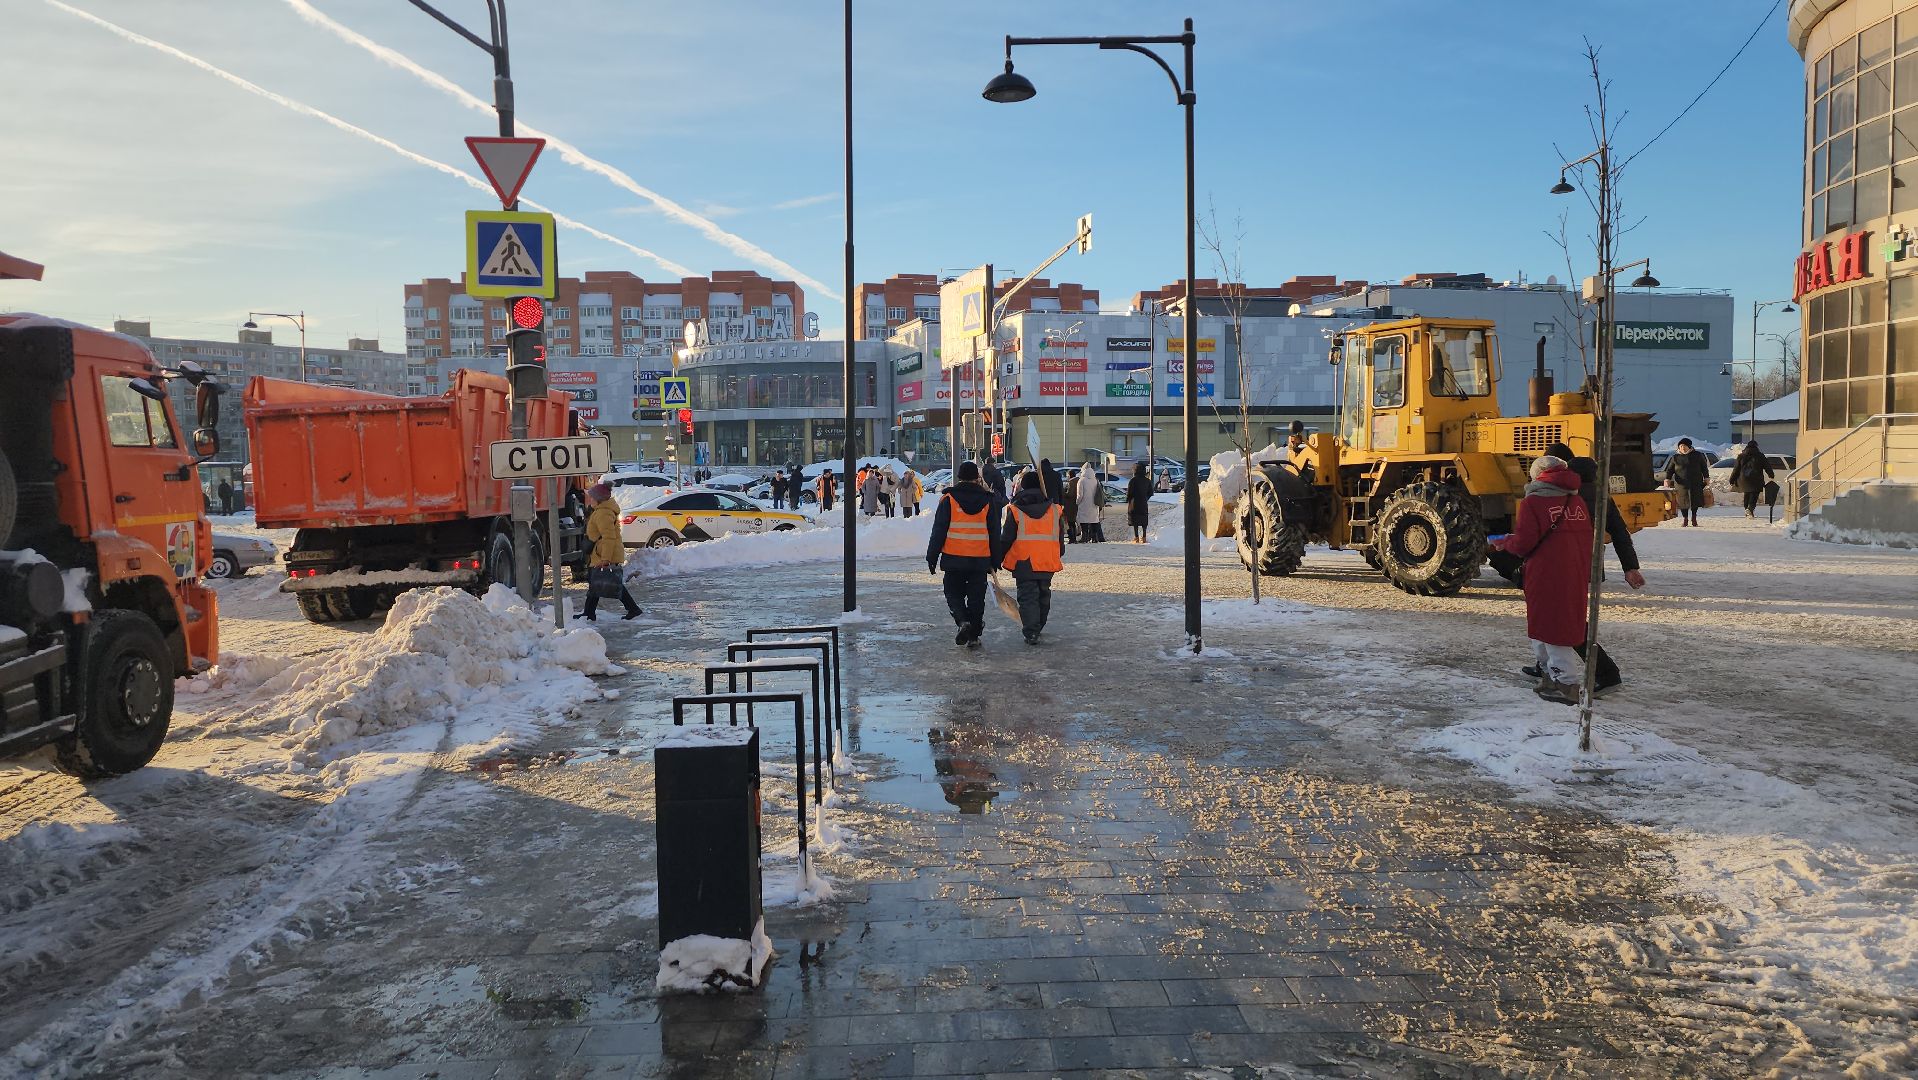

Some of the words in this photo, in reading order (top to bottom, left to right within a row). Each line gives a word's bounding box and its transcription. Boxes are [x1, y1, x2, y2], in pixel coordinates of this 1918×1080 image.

[696, 311, 820, 346] АТЛАС
[1616, 325, 1704, 343] Перекрёсток
[755, 345, 811, 359] ЦЕНТР
[508, 444, 593, 472] СТОП
